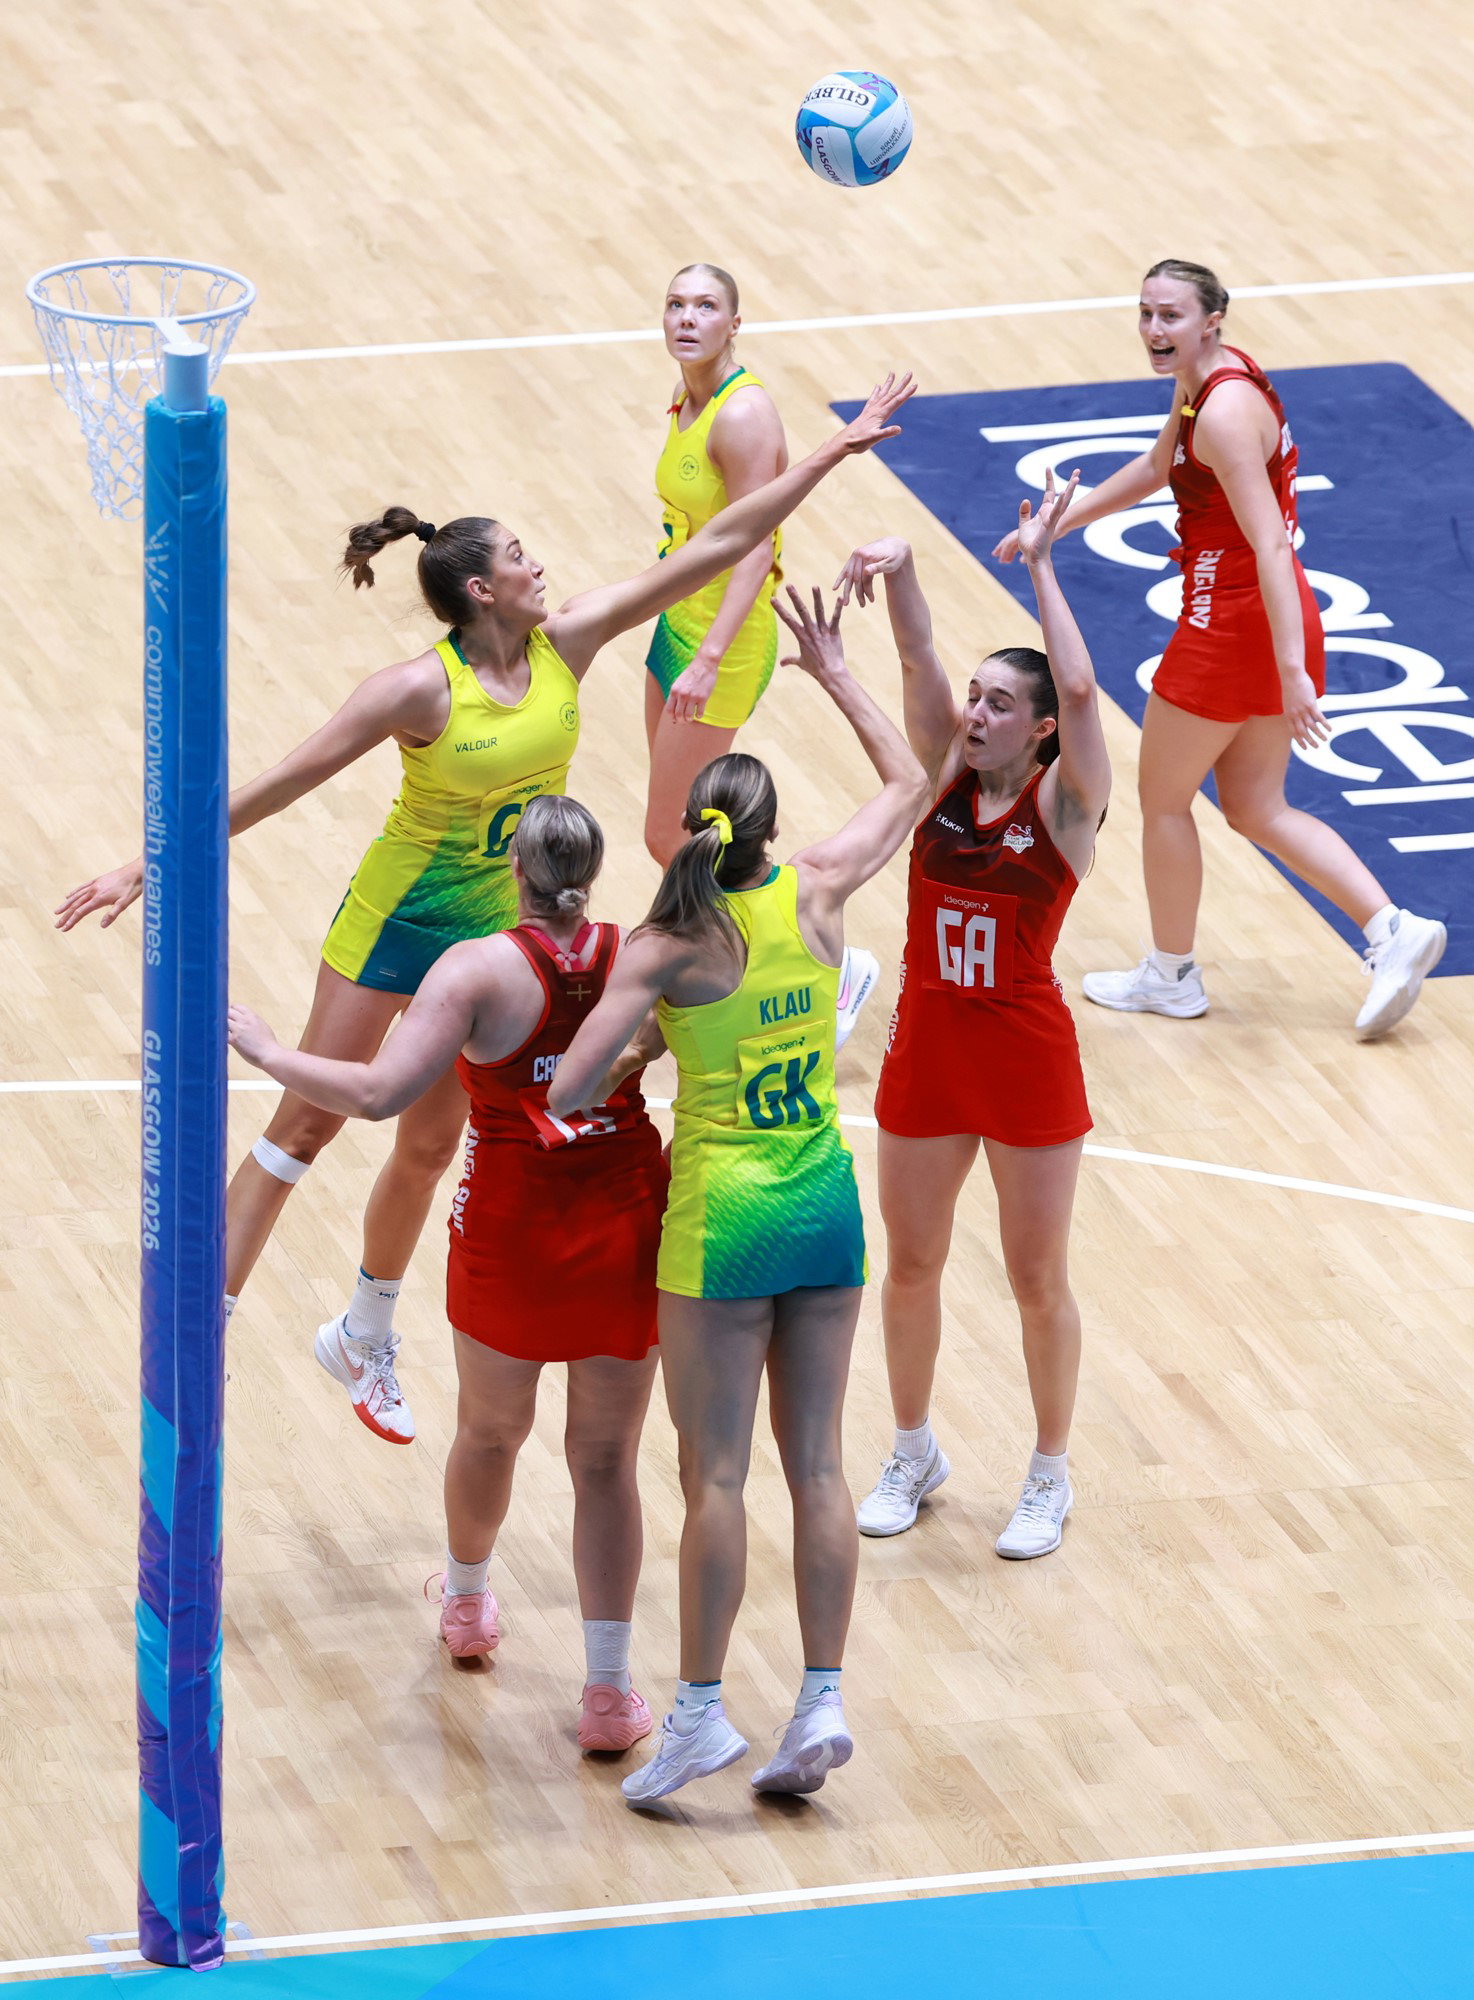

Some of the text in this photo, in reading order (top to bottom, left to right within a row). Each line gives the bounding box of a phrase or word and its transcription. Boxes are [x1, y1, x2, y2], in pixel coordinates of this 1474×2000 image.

[815, 136, 841, 182] GLASGOW
[455, 736, 498, 753] VALOUR
[144, 625, 167, 967] commonwealth games
[940, 816, 965, 834] KUKRI
[943, 894, 981, 910] Ideagen
[936, 906, 997, 989] GA
[759, 987, 812, 1026] KLAU
[761, 1039, 798, 1056] Ideagen
[744, 1050, 821, 1129] GK
[142, 1029, 162, 1251] GLASGOW 2026
